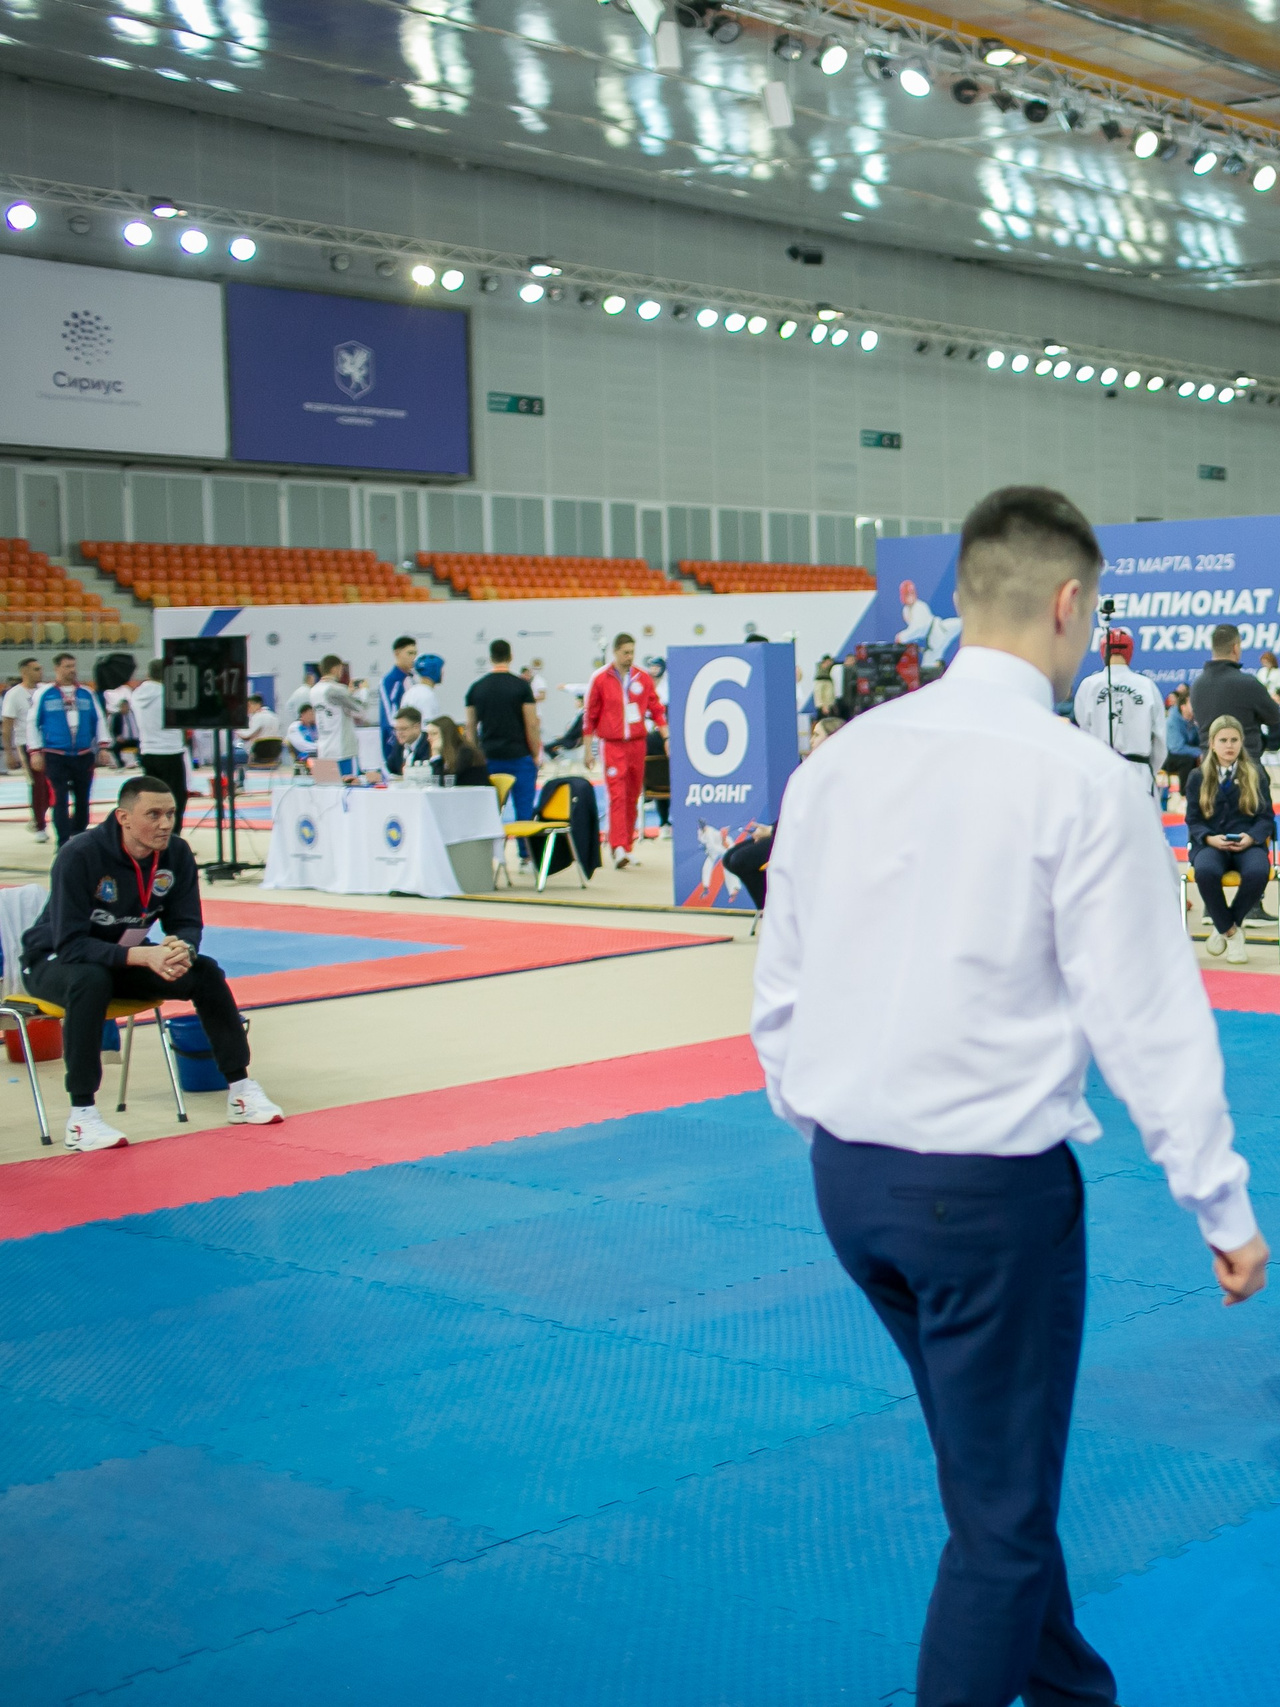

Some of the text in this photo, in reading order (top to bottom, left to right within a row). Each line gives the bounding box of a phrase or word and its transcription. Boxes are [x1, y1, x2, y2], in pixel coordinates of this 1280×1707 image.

[52, 371, 124, 395] Сириус
[1137, 555, 1193, 574] МАРТА
[1195, 553, 1236, 572] 2025
[1096, 684, 1144, 706] TAEWON-DO
[683, 656, 752, 778] 6
[685, 783, 752, 806] ДОЯНГ
